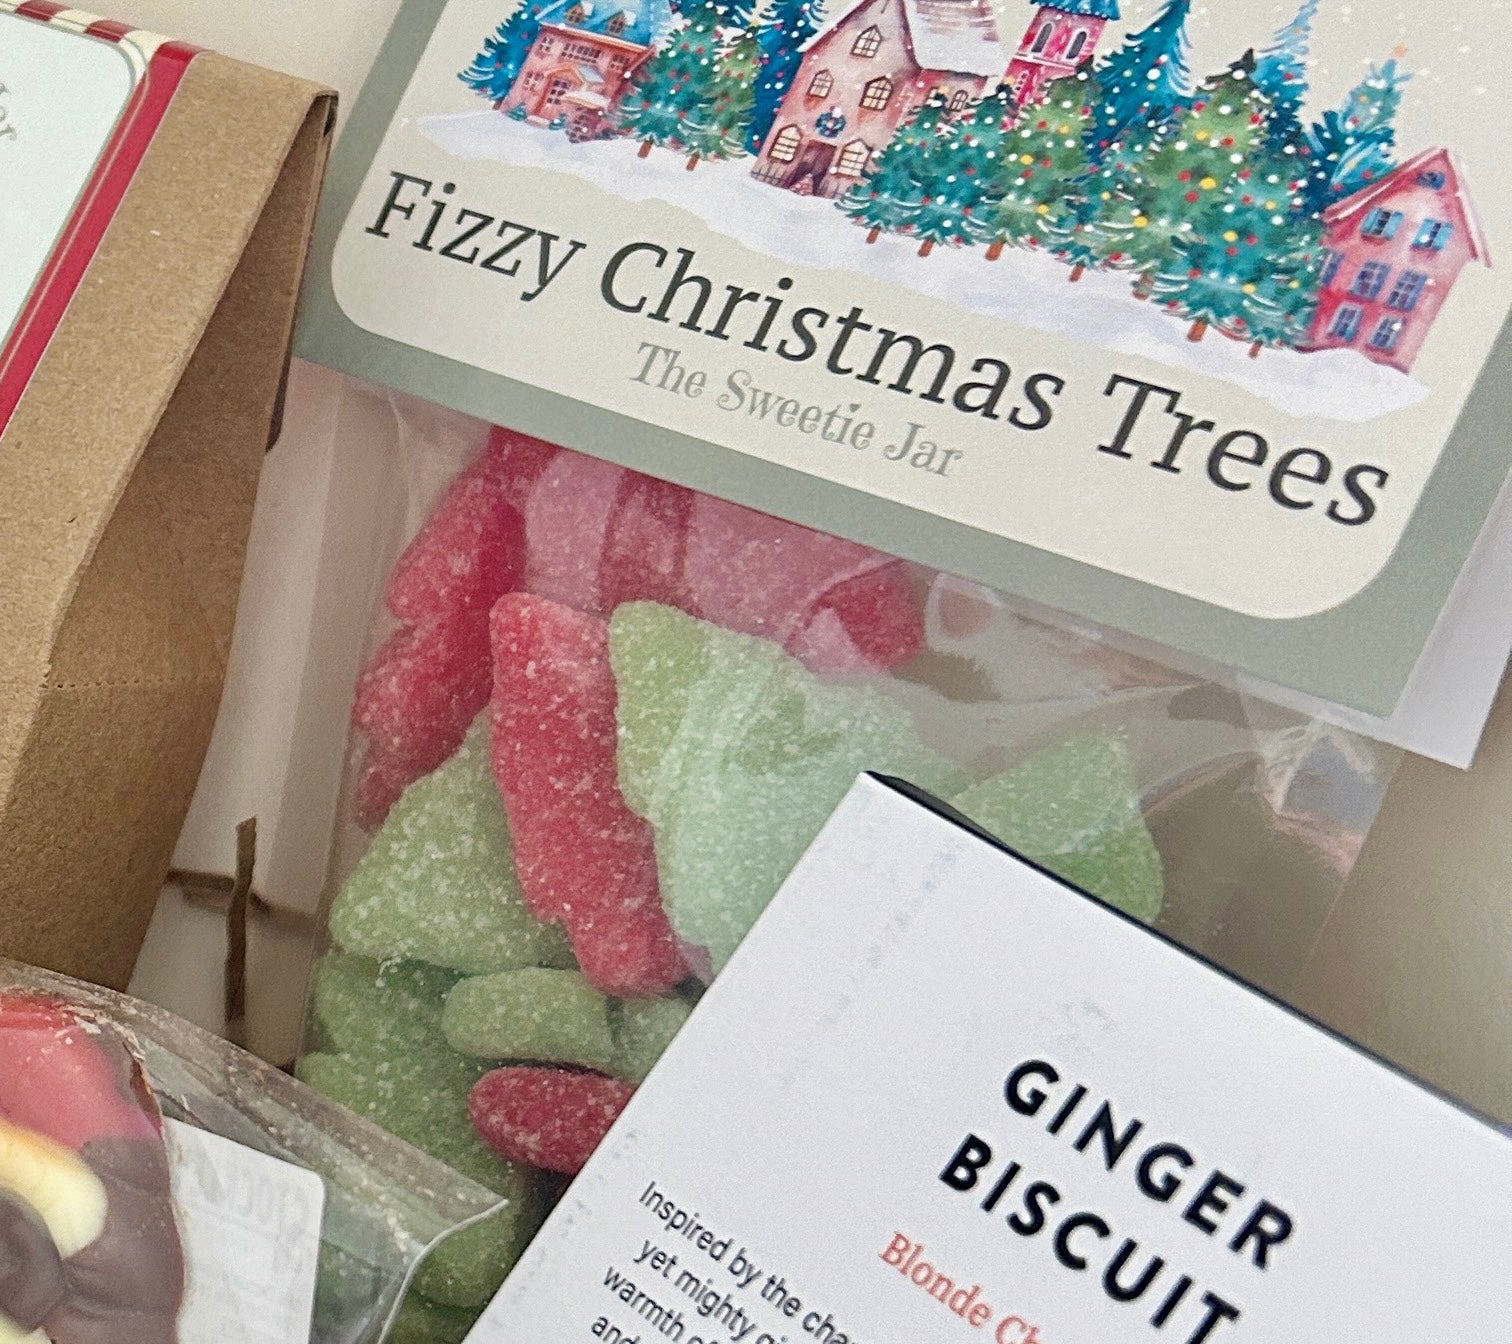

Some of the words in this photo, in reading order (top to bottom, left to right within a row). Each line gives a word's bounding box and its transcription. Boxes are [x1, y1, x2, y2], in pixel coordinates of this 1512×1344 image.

[364, 171, 587, 302] Fizzy
[600, 241, 1066, 432] Christmas
[1097, 373, 1389, 527] Trees
[630, 342, 707, 399] The
[717, 368, 877, 451] Sweetie
[884, 421, 965, 479] Jar
[1003, 1058, 1295, 1271] GINGER
[603, 1266, 686, 1343] warmth
[633, 1240, 678, 1279] yet
[674, 1267, 757, 1342] mighty
[638, 1181, 737, 1262] Inspired
[728, 1247, 764, 1289] by
[759, 1274, 803, 1317] the
[877, 1231, 993, 1329] Blonde
